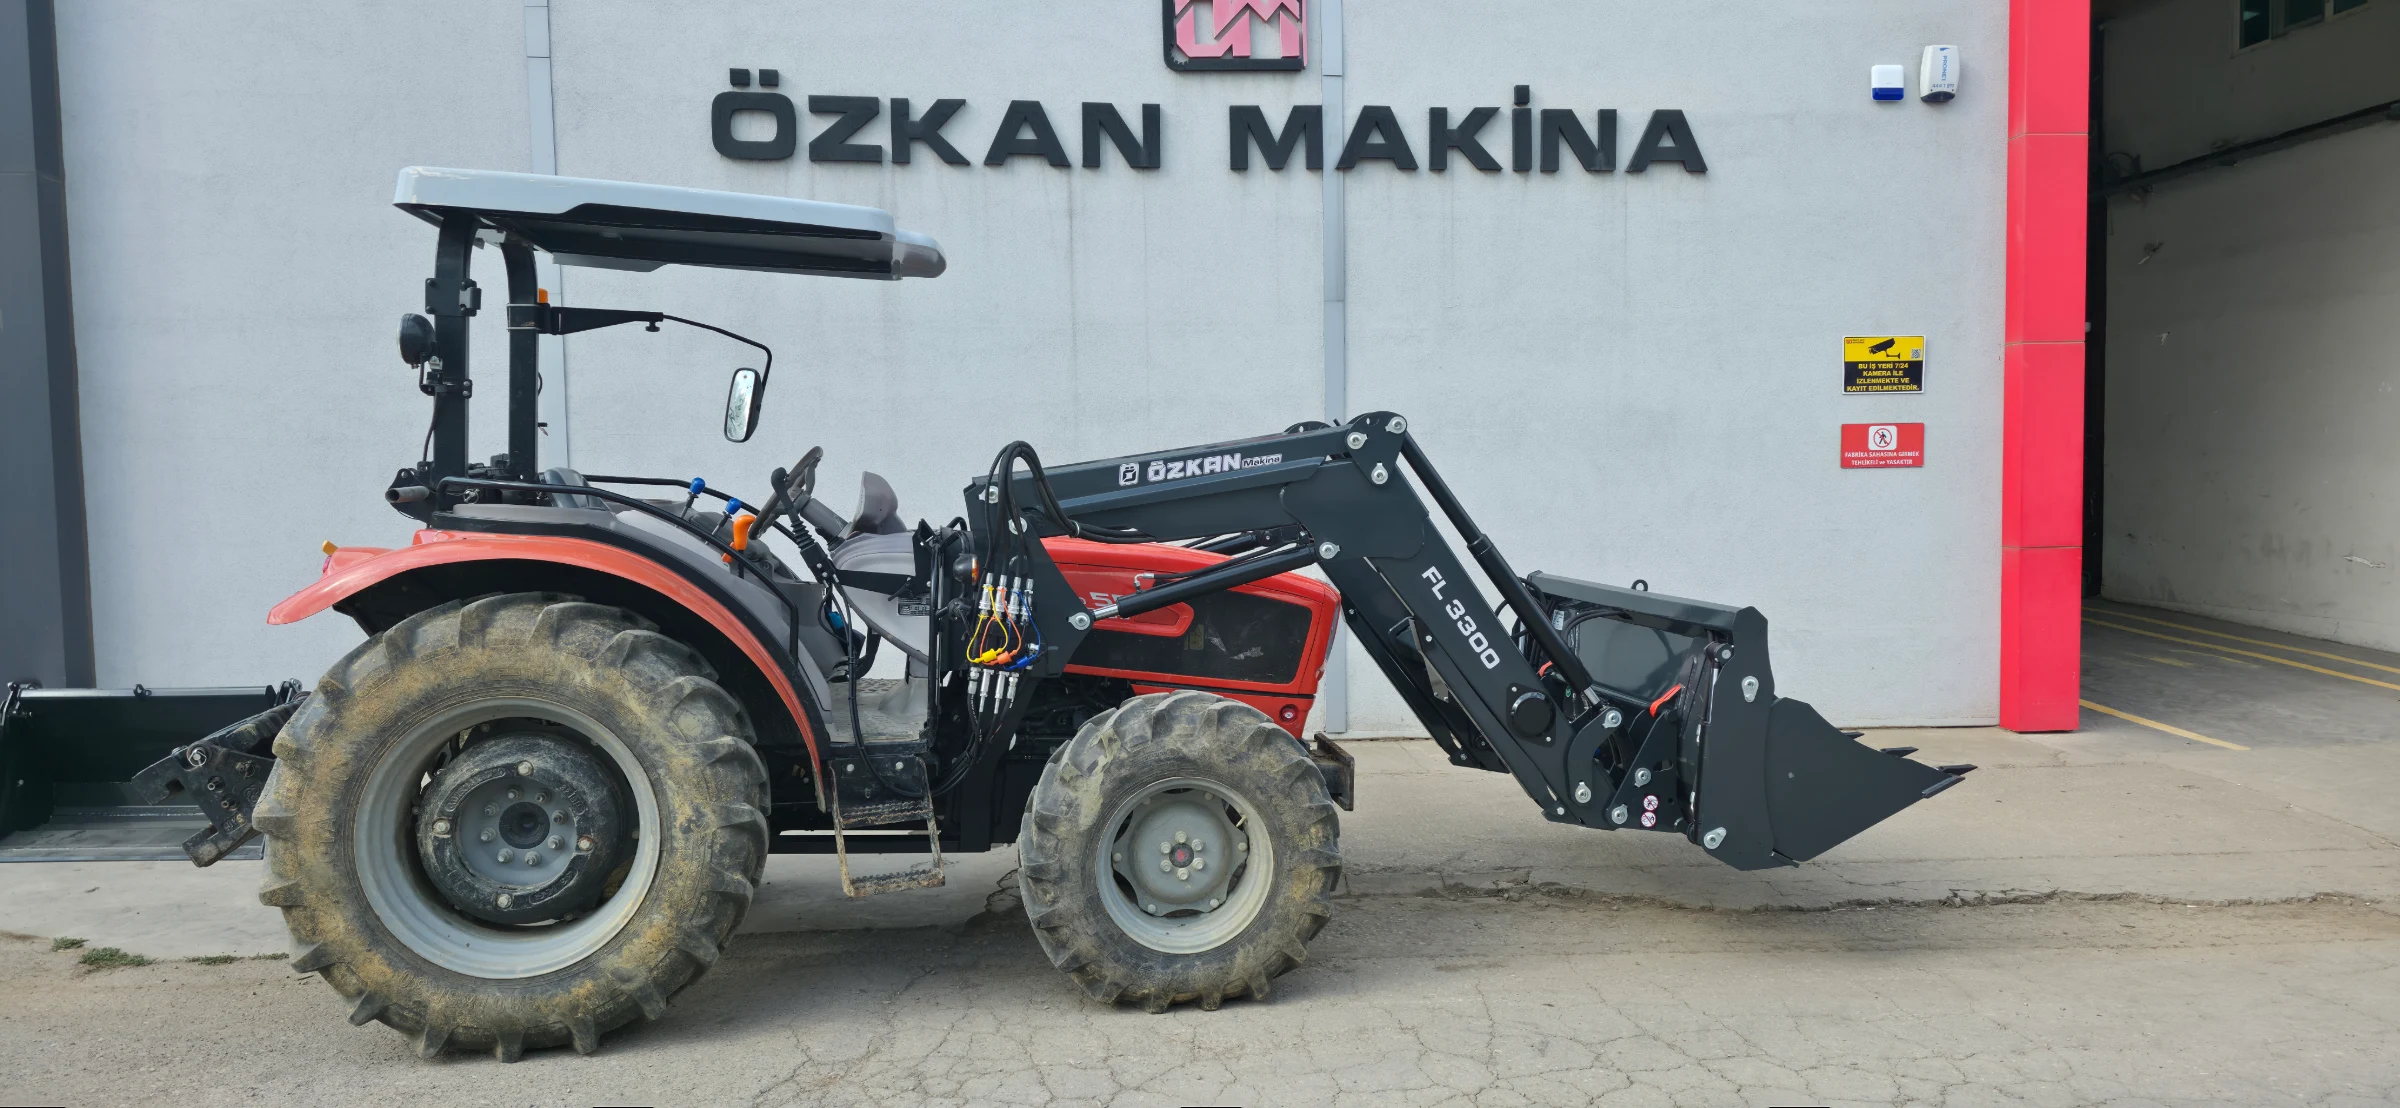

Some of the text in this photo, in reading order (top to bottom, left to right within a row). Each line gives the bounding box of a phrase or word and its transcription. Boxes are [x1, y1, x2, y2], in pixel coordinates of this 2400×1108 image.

[711, 67, 1708, 173] ÖZKAN MAKİNA
[1146, 452, 1242, 483] ÖZKAN
[1243, 455, 1281, 468] Makina
[1421, 565, 1500, 670] FL 3300
